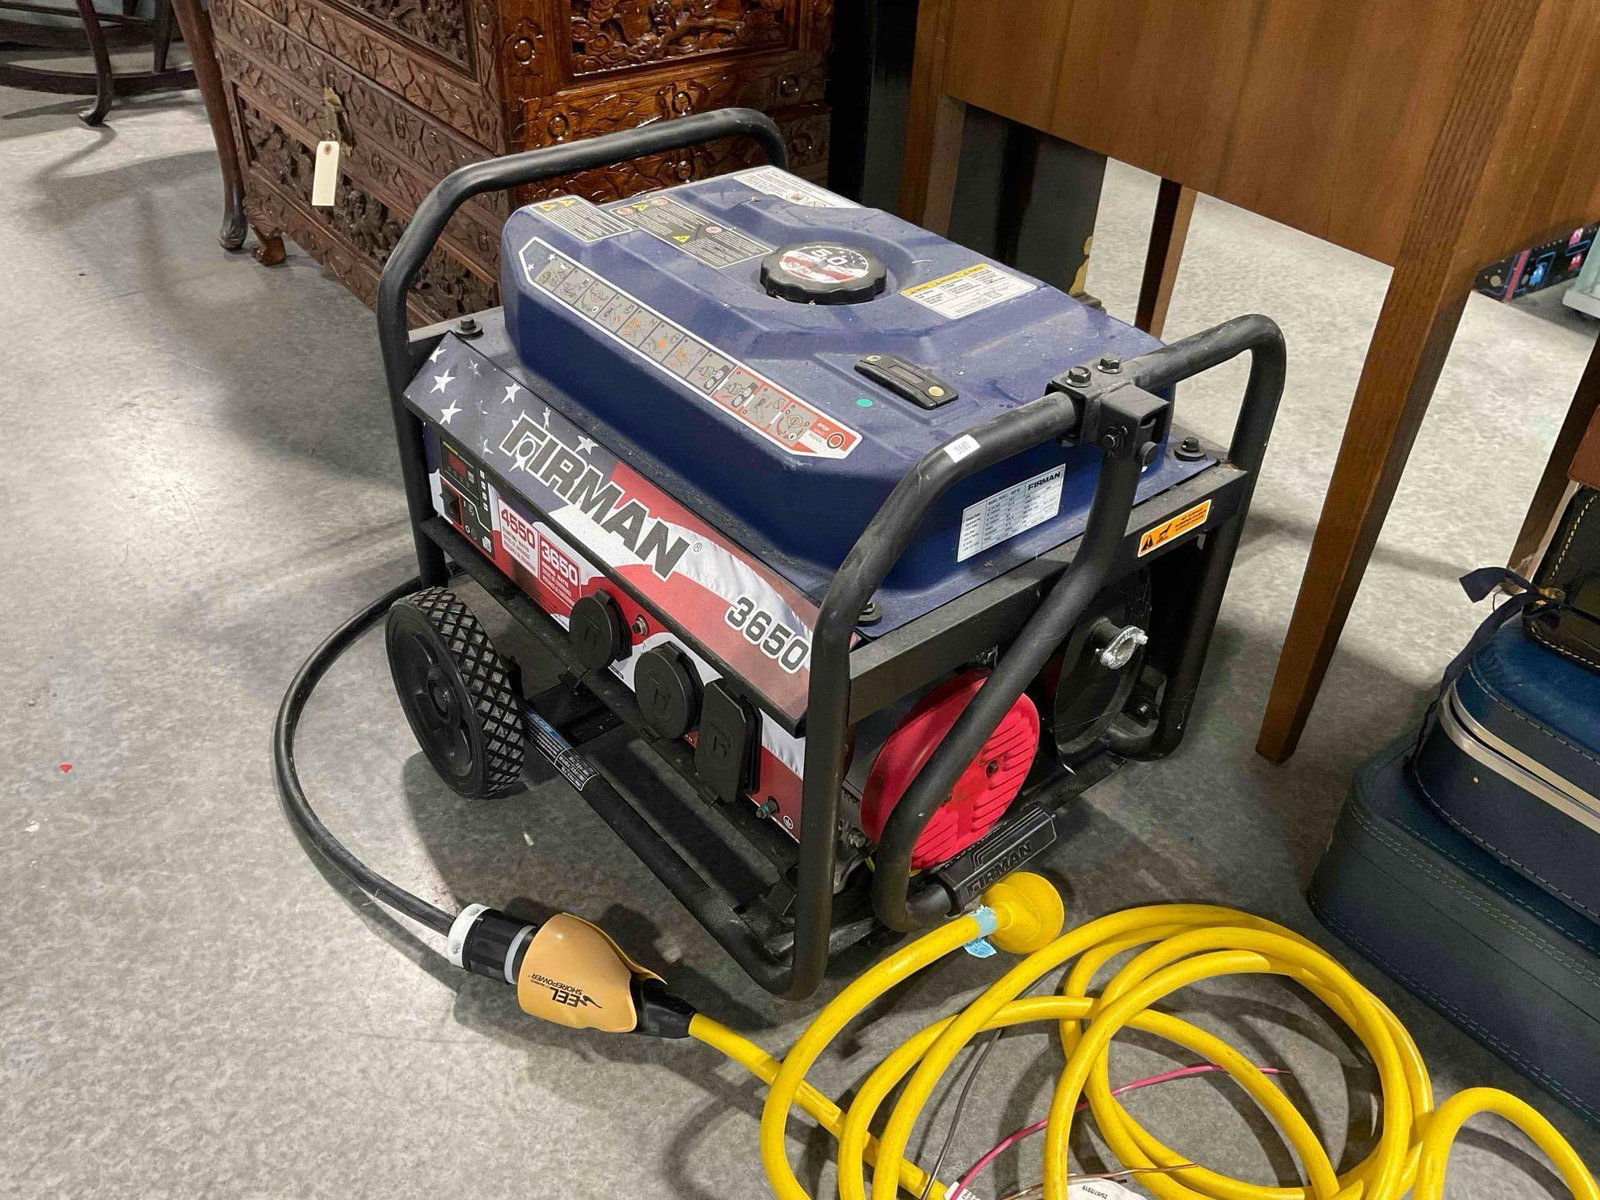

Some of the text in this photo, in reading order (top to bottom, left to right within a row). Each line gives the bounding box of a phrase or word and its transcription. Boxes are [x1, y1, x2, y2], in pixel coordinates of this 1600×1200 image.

[500, 414, 691, 582] FIRMAN
[1027, 471, 1061, 491] FIRMAN
[501, 508, 536, 550] 4550
[541, 539, 578, 587] 3650
[726, 595, 811, 672] 3650
[966, 840, 1033, 897] FIRMAN
[531, 973, 583, 996] SHOREPOWER
[549, 986, 584, 1008] EEL
